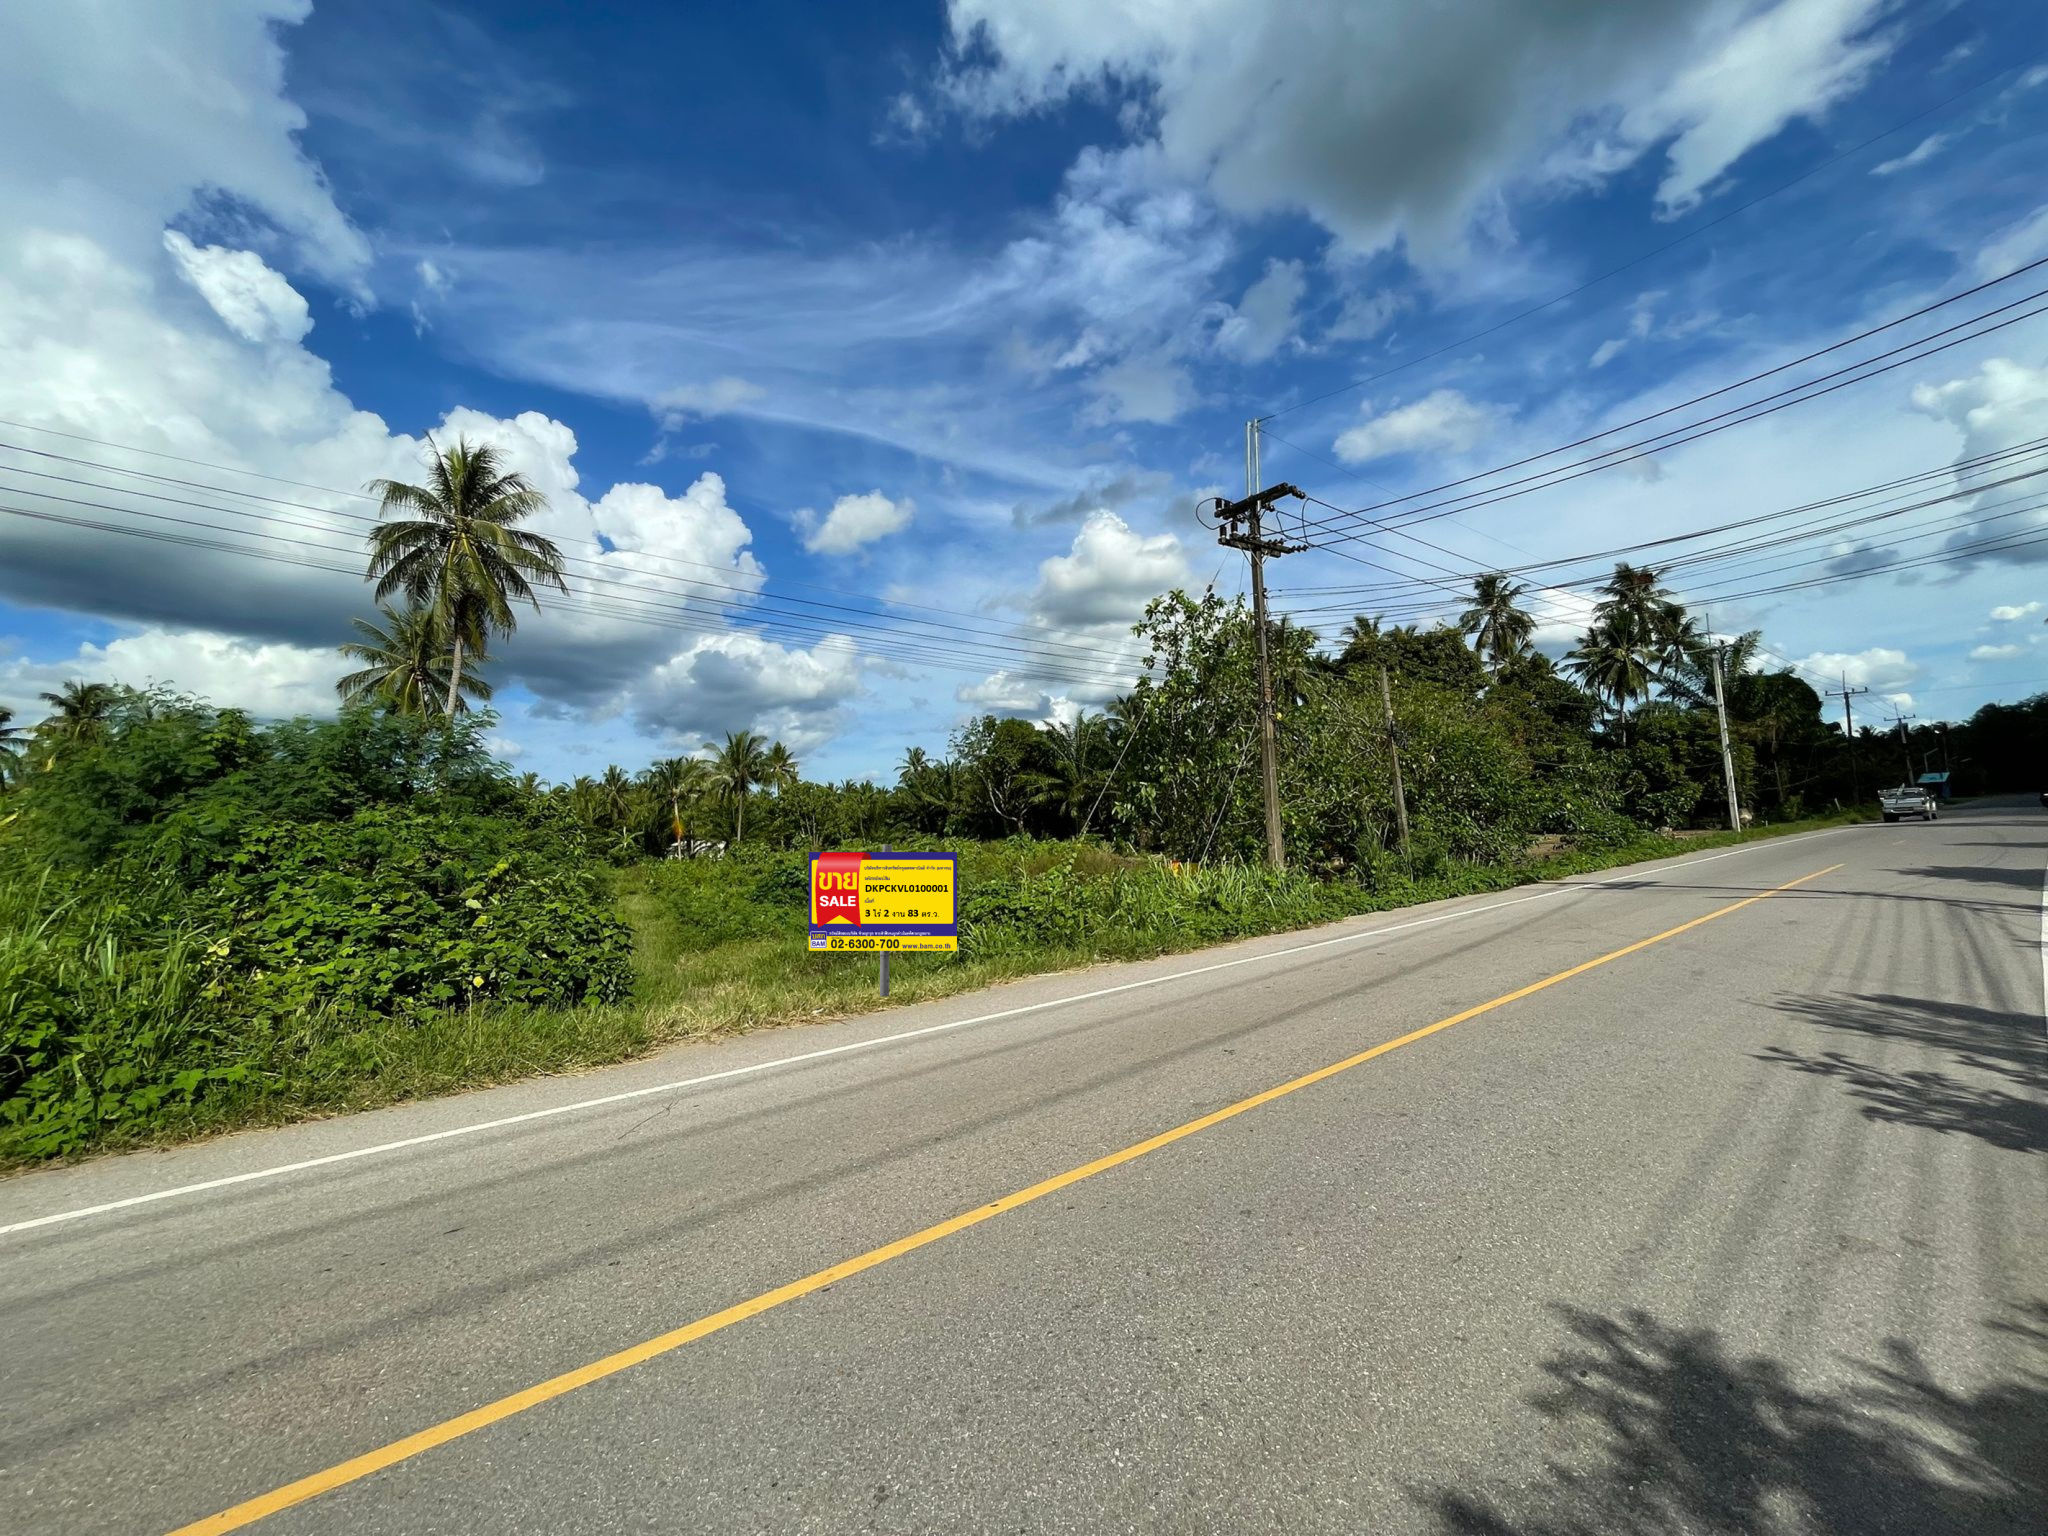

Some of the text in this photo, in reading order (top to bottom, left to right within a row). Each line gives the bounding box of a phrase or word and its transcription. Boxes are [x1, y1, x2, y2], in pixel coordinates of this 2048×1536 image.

[819, 872, 857, 890] ขาย
[865, 884, 949, 893] DKPCKVL0100001
[819, 895, 857, 907] SALE
[865, 909, 871, 917] 3
[883, 909, 890, 917] 2
[907, 909, 919, 917] 83
[830, 939, 900, 949] 02-6300-700
